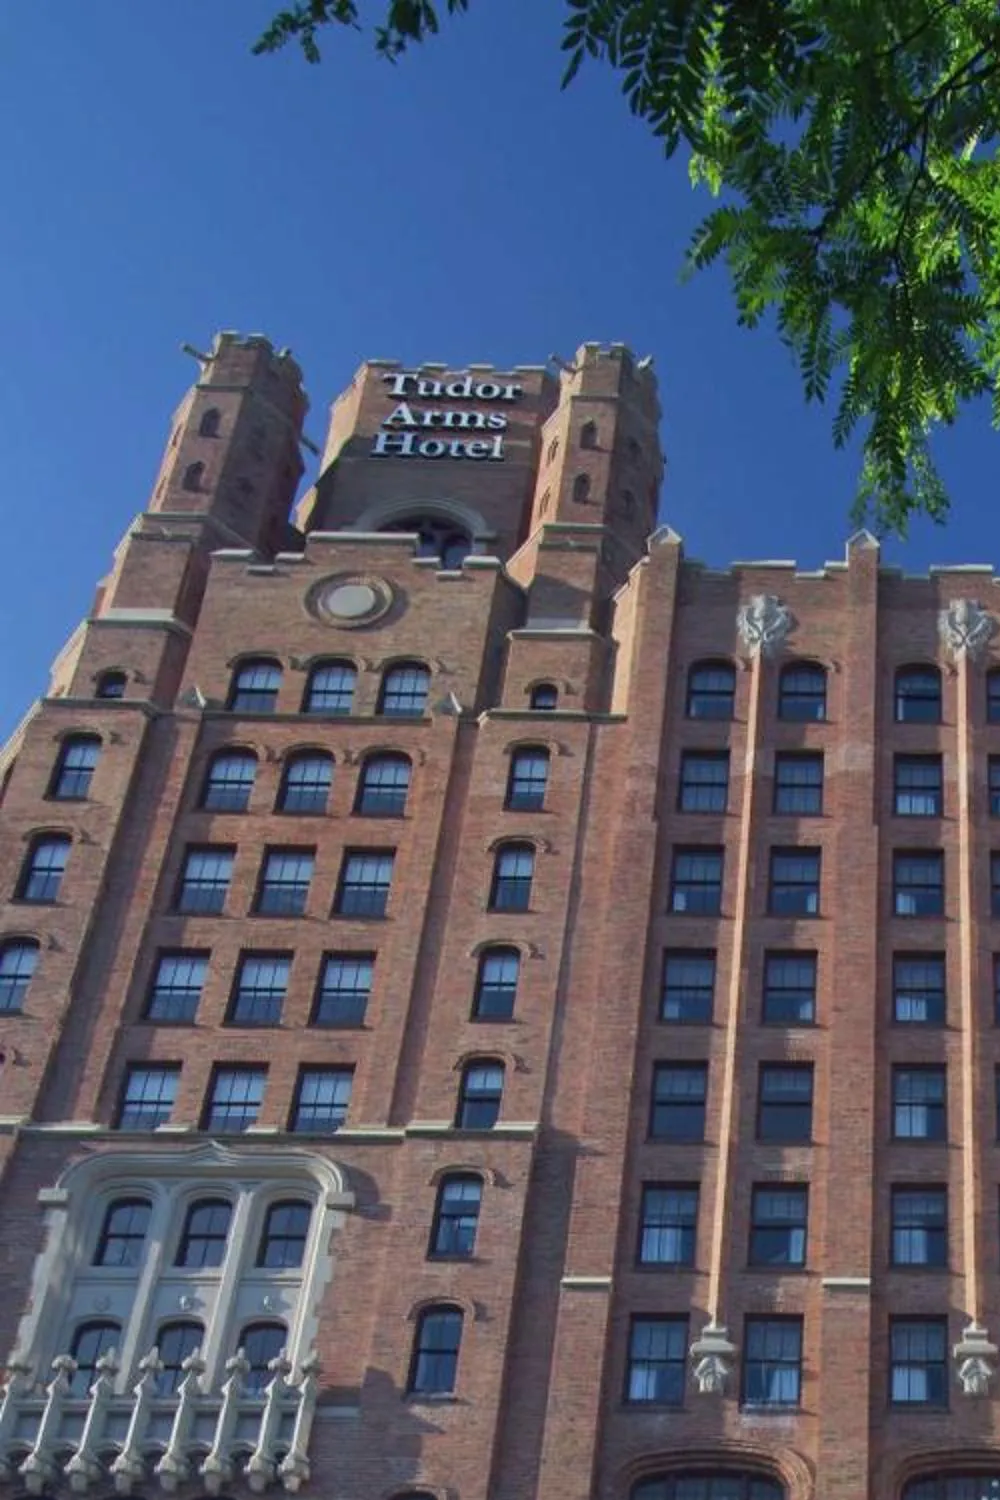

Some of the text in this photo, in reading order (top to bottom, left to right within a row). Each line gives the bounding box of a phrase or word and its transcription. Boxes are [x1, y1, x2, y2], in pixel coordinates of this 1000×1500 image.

[382, 372, 523, 399] Tudor
[381, 401, 508, 429] Arms
[370, 431, 504, 461] Hotel
